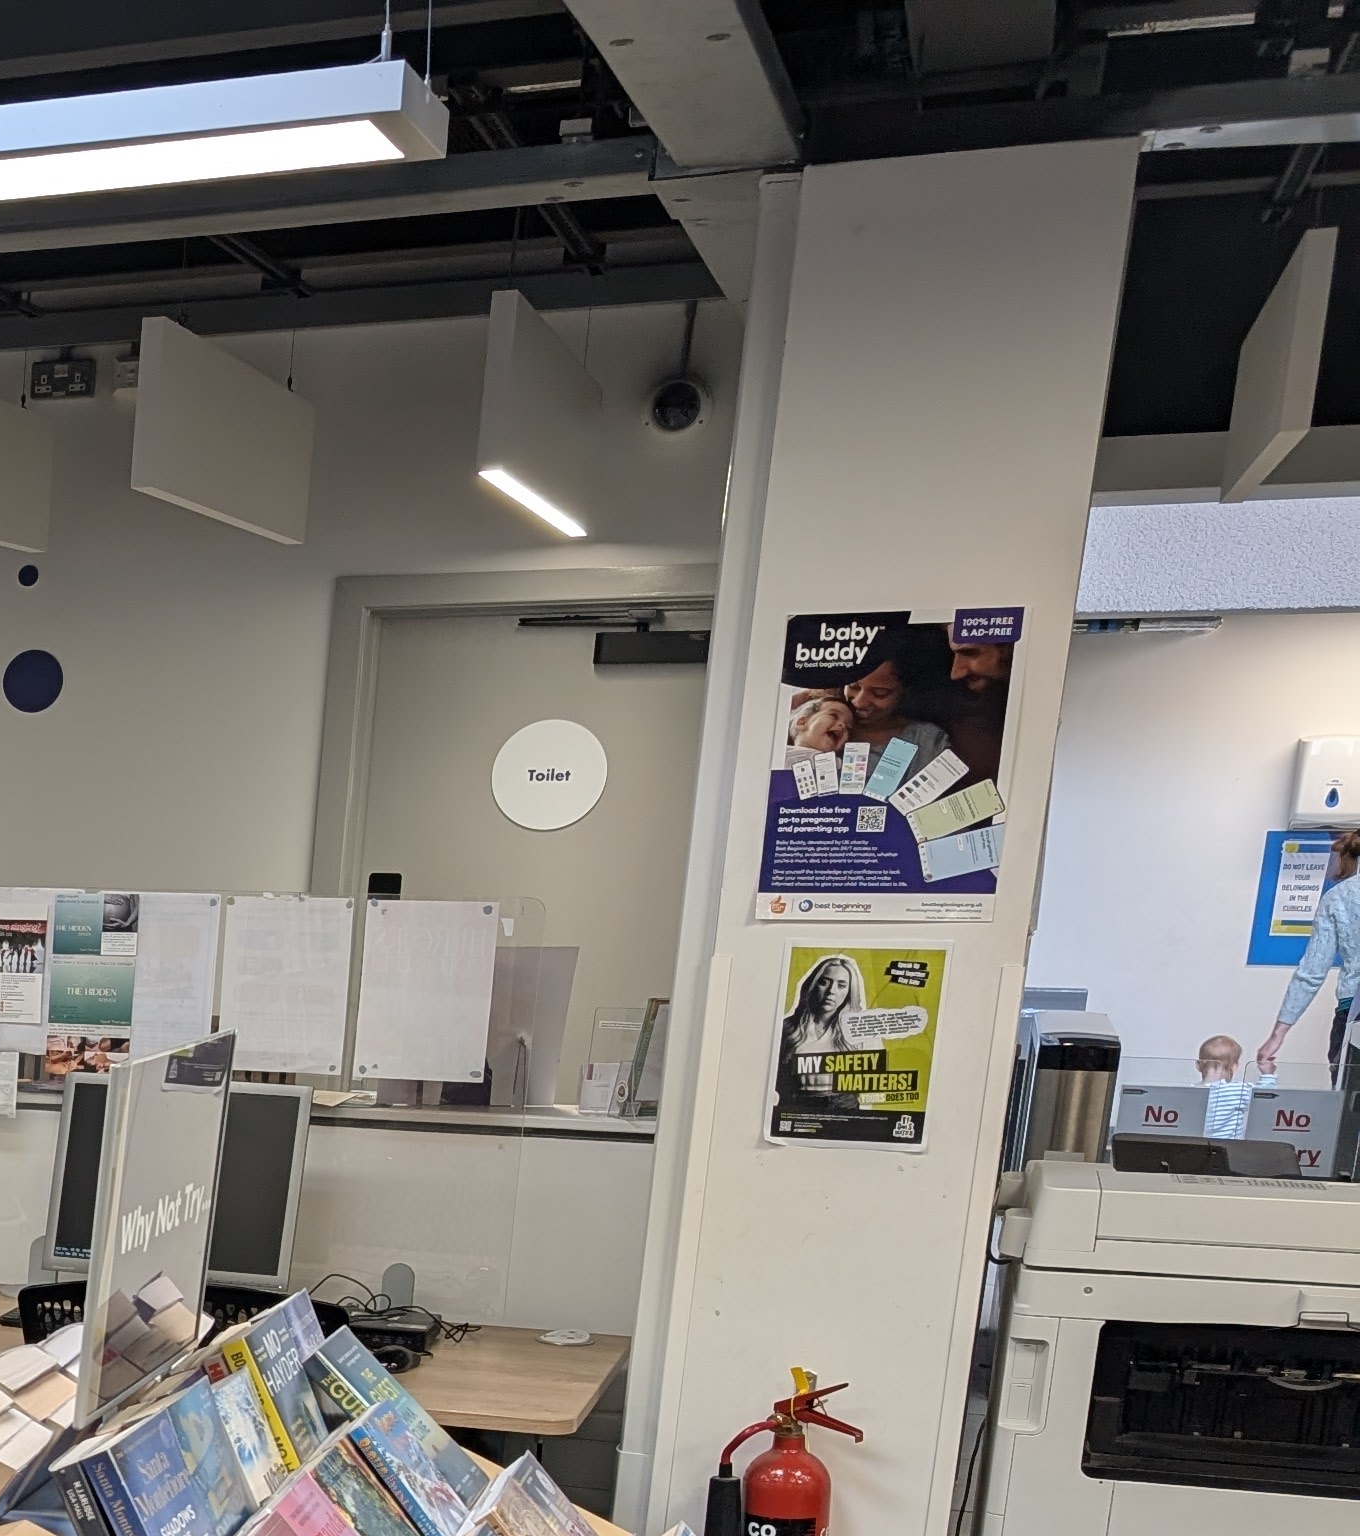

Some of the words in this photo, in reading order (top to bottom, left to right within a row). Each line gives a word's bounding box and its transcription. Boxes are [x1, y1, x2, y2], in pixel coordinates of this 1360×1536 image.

[962, 617, 988, 626] 100%
[990, 617, 1014, 625] FREE
[820, 621, 879, 644] baby
[795, 641, 868, 665] buddy
[795, 661, 804, 670] by
[819, 660, 854, 669] beginnings
[526, 767, 572, 785] Toilet
[779, 806, 819, 815] Download
[819, 806, 833, 814] the
[834, 806, 851, 814] free
[777, 825, 793, 833] and
[793, 825, 832, 834] parenting
[833, 826, 849, 834] app
[778, 816, 800, 825] go-to
[800, 816, 843, 826] pregnancy
[1305, 863, 1326, 871] LEAVE
[814, 901, 831, 909] best
[831, 902, 872, 911] beginnings
[10, 921, 43, 934] singing?
[65, 986, 83, 996] THE
[83, 987, 118, 997] HIDDEN
[797, 1055, 823, 1075] MY
[824, 1052, 880, 1073] SAFETY
[837, 1073, 912, 1092] MATTERS!
[1144, 1105, 1179, 1124] No
[1275, 1108, 1311, 1129] No
[120, 1204, 157, 1255] Why
[155, 1189, 183, 1234] Not
[184, 1182, 212, 1227] Try...
[261, 1328, 282, 1360] MO
[261, 1346, 304, 1398] HAYDER
[91, 1462, 115, 1498] Santa
